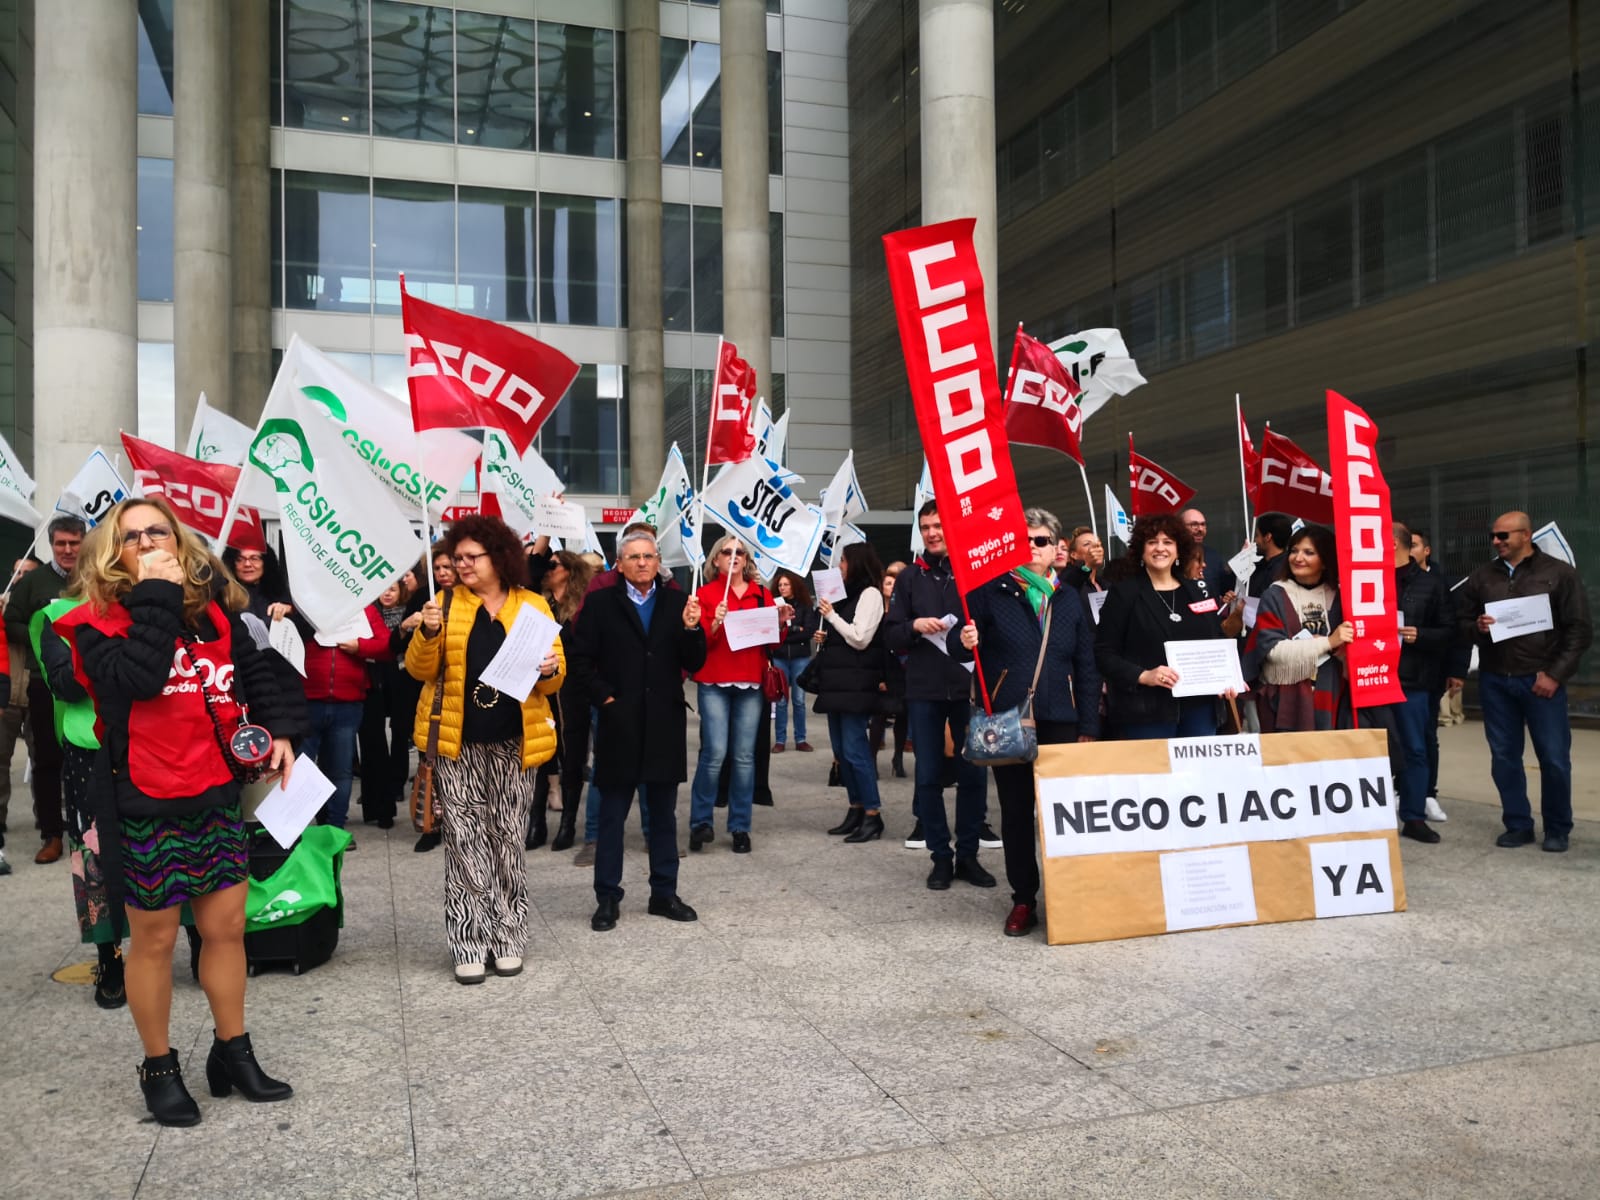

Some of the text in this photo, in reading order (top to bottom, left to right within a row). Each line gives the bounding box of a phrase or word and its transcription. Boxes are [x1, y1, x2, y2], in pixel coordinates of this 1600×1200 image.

[908, 240, 998, 496] CCOO
[741, 478, 796, 533] STAJ
[1344, 409, 1386, 616] CCOO
[1002, 531, 1015, 544] de
[311, 543, 329, 561] DE
[324, 557, 364, 598] MURCIA
[970, 543, 1016, 571] murcia
[1357, 675, 1390, 687] murcia
[1379, 663, 1390, 674] de
[1173, 742, 1259, 760] MINISTRA
[1322, 863, 1385, 897] YA
